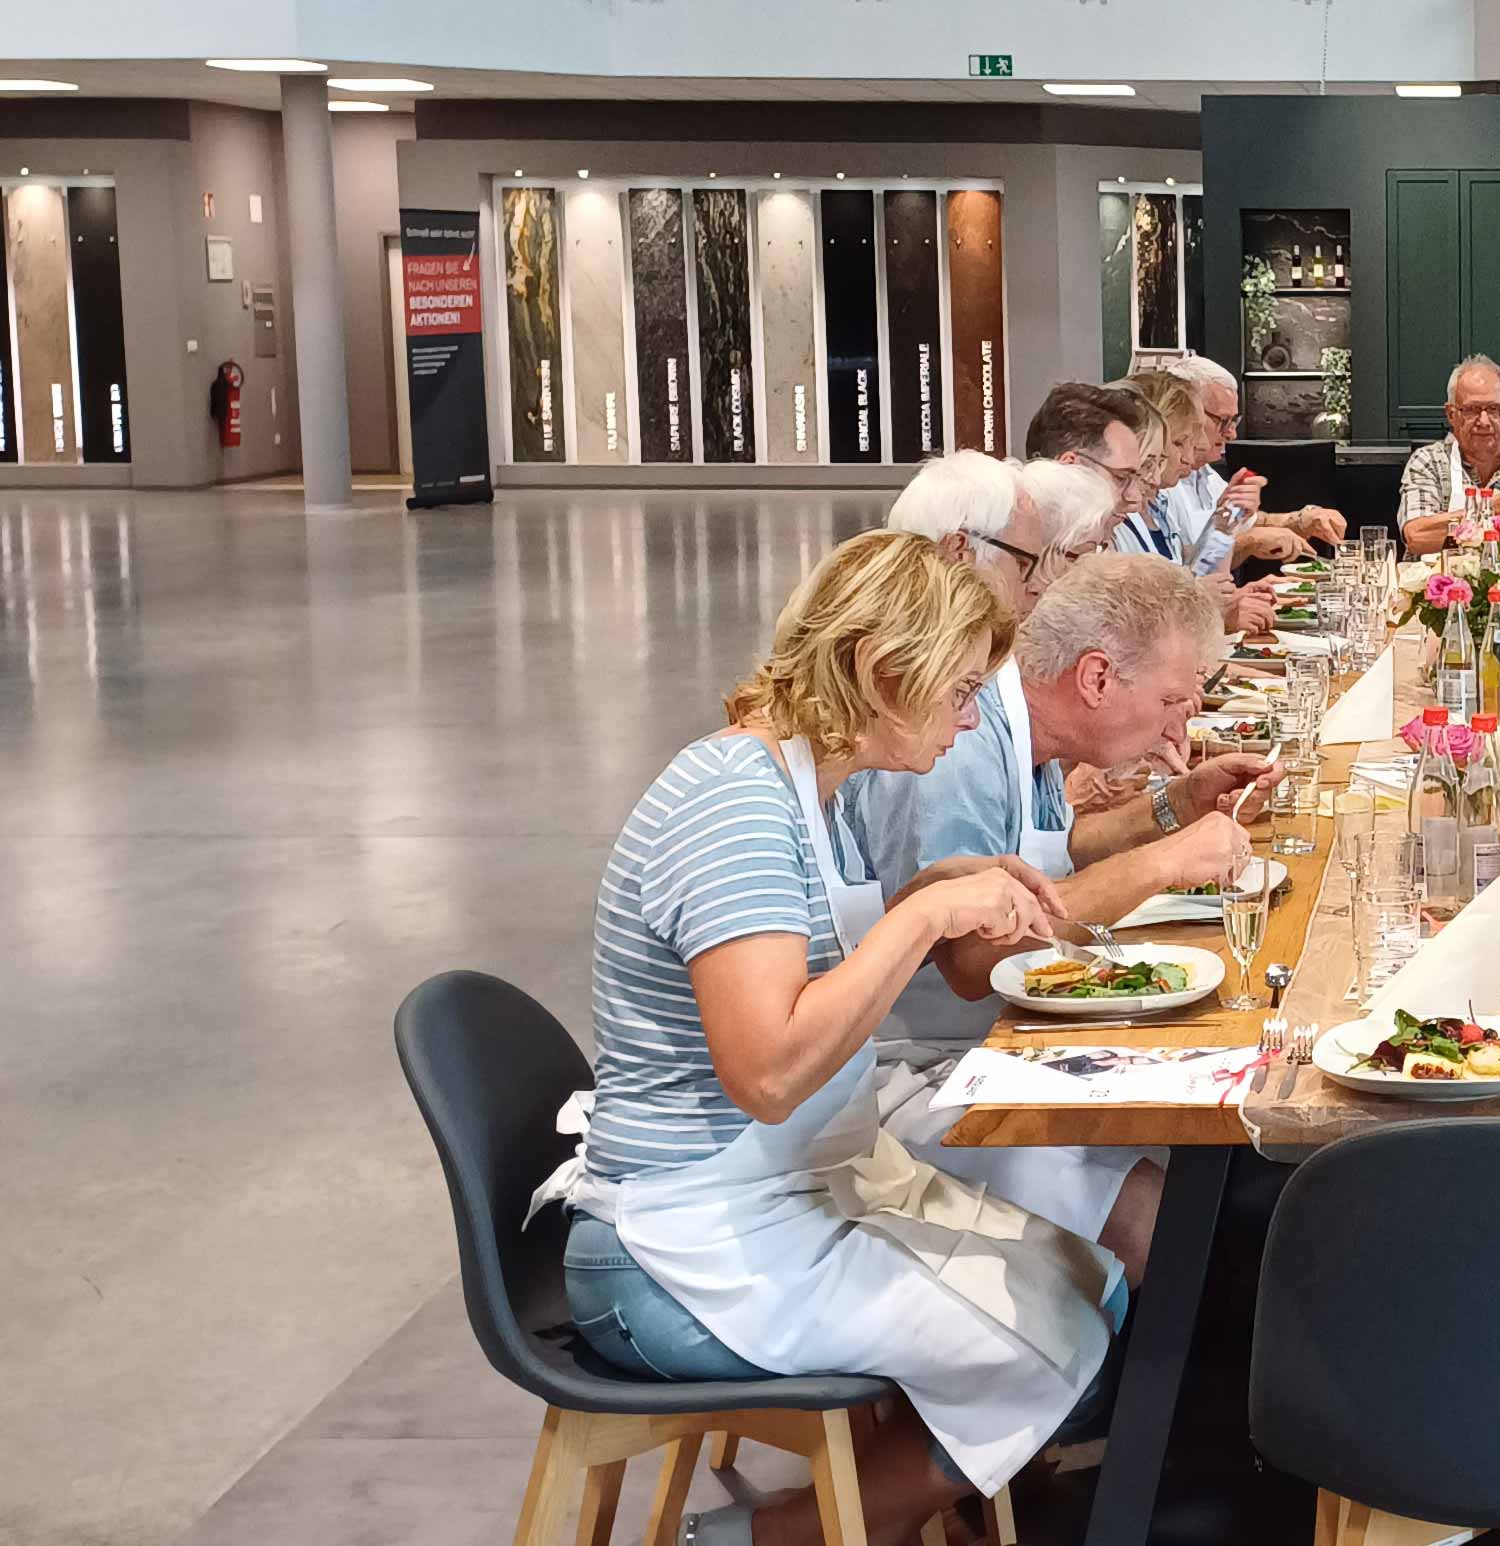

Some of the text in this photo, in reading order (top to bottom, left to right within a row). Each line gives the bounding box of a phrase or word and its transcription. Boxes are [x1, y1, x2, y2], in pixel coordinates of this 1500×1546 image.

[408, 278, 478, 293] NACH UNSEREN
[409, 294, 473, 309] BESONDEREN
[667, 357, 679, 401] BROWN
[730, 368, 744, 452] BLACK COSMIC
[856, 368, 869, 452] BENGAL BLACK
[918, 343, 932, 452] BRECCIA IMPERIALE
[981, 340, 994, 452] BROWN CHOCOLATE
